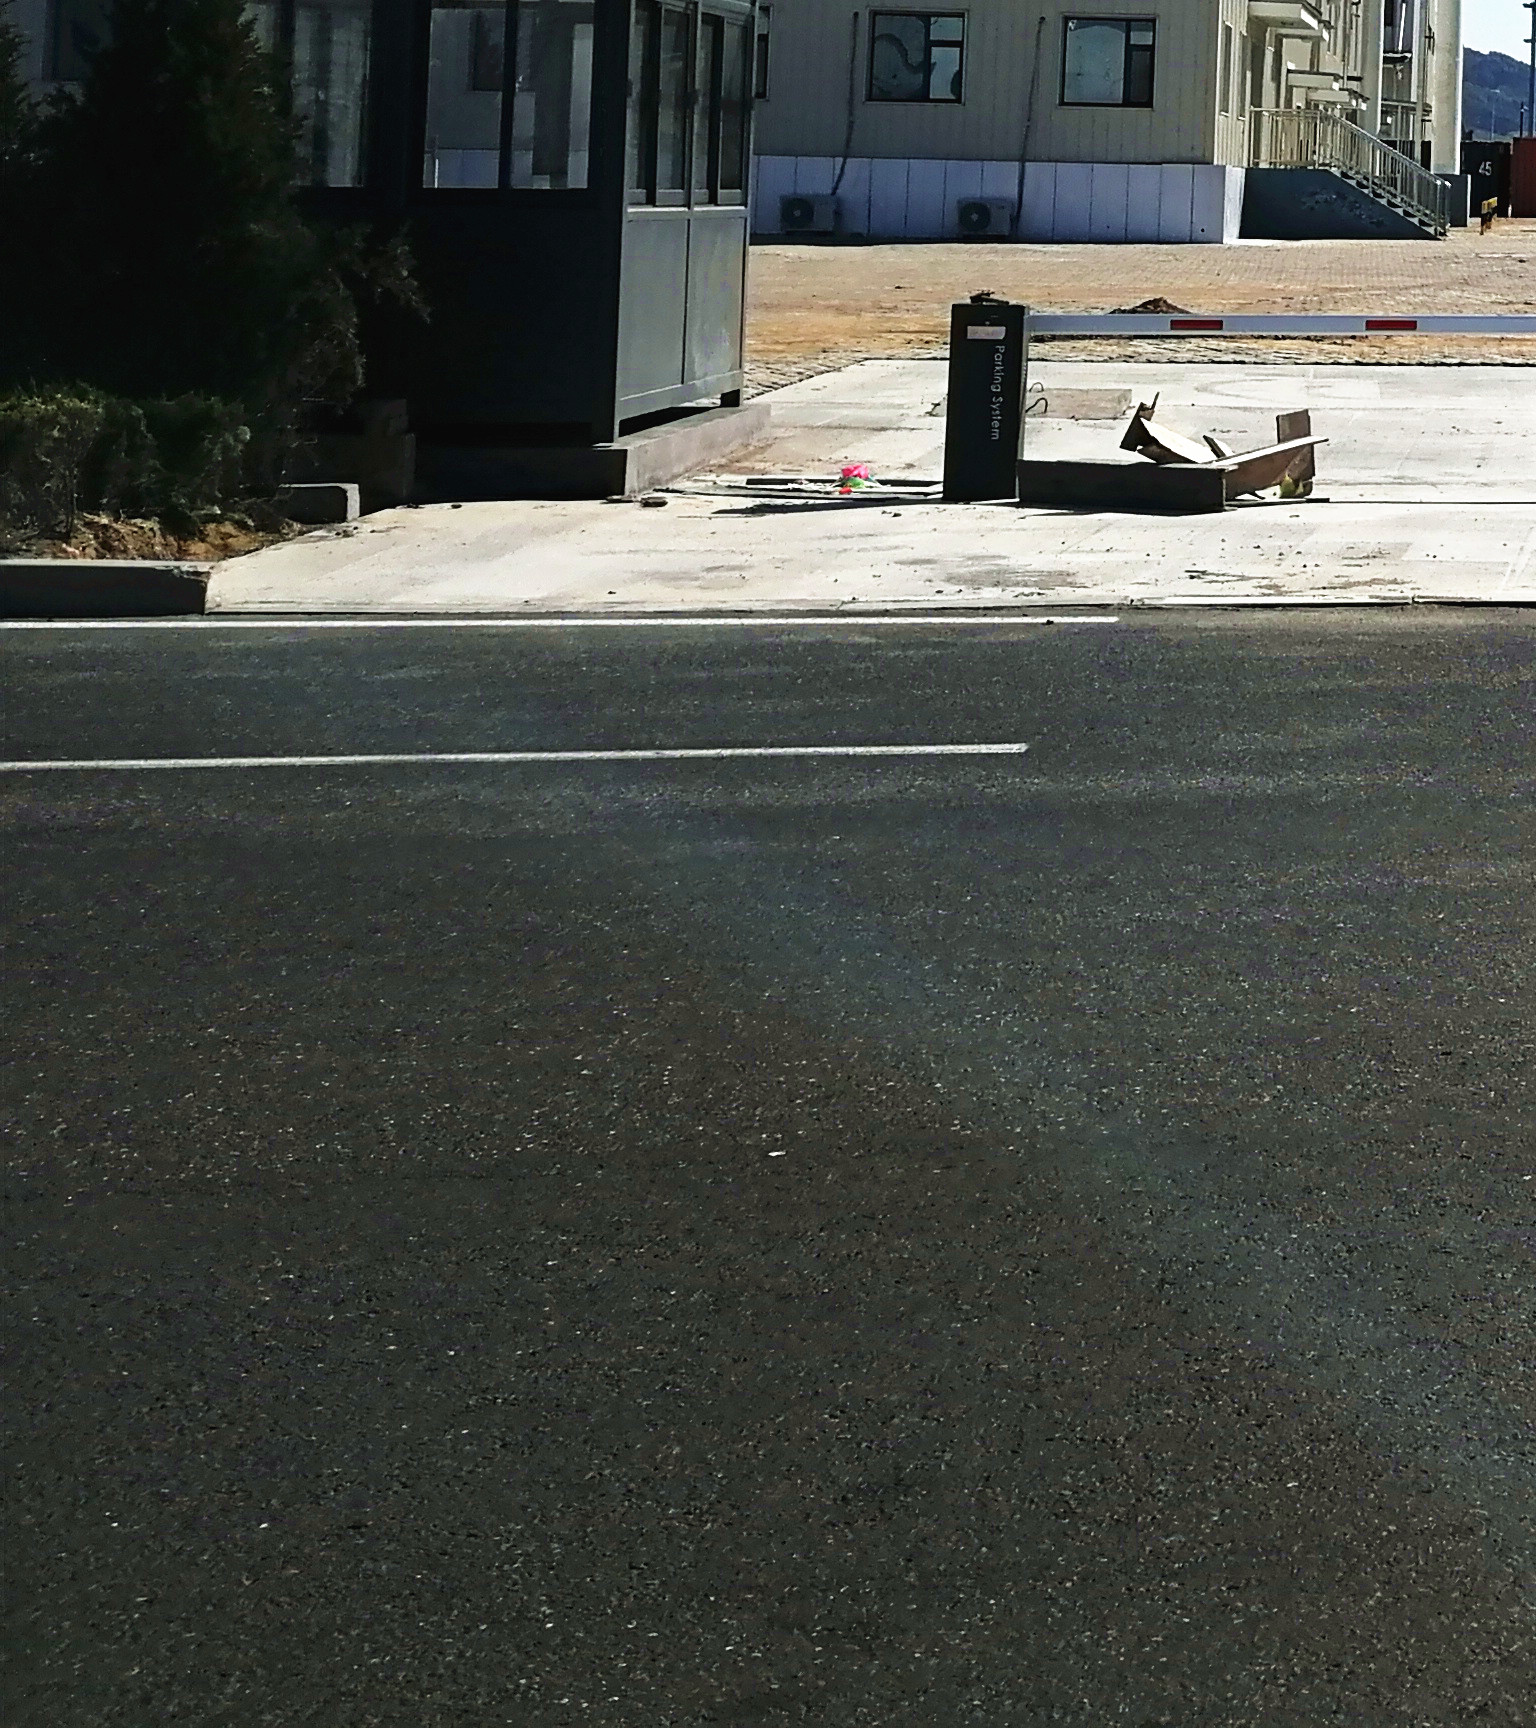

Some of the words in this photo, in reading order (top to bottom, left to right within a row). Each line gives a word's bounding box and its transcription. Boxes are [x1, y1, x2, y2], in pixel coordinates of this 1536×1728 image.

[1478, 161, 1492, 176] 45
[990, 345, 1005, 393] Parking
[990, 396, 1003, 441] System
